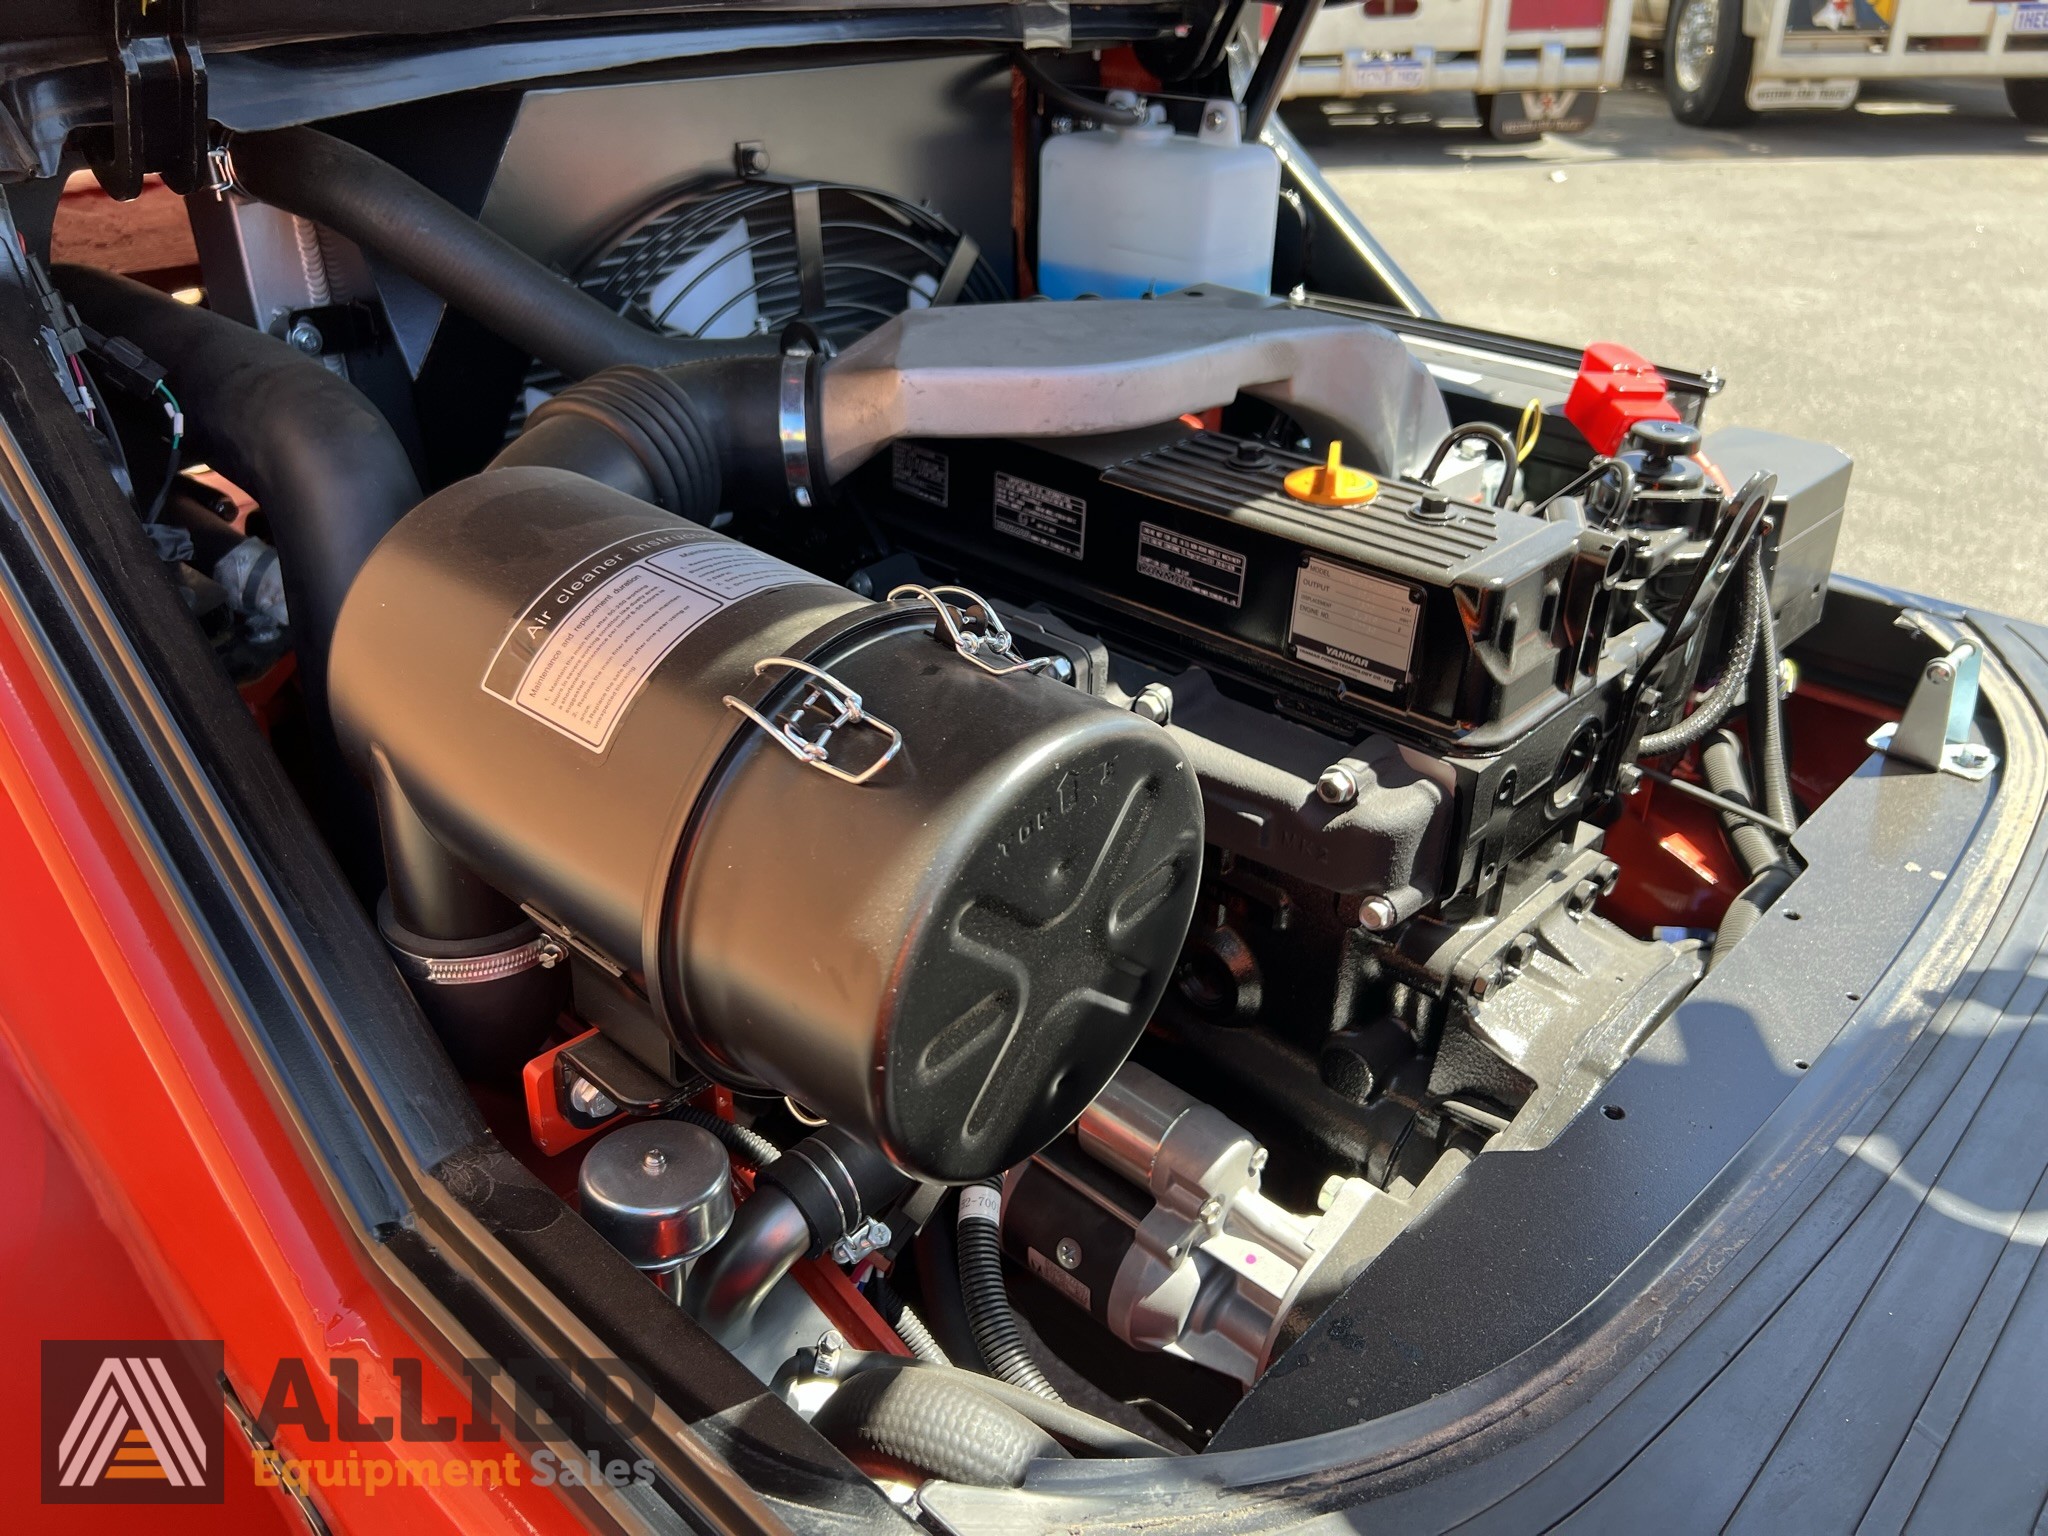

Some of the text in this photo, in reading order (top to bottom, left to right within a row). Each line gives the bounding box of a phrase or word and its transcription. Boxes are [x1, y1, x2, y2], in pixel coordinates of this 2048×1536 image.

[1310, 565, 1331, 577] MODEL
[1303, 578, 1330, 592] OUTPUT
[526, 610, 553, 640] Air
[557, 552, 624, 605] cleaner
[1300, 603, 1319, 615] ENGINE
[529, 575, 641, 697] Maintenance and replacement duration
[1325, 646, 1369, 667] YANMAR
